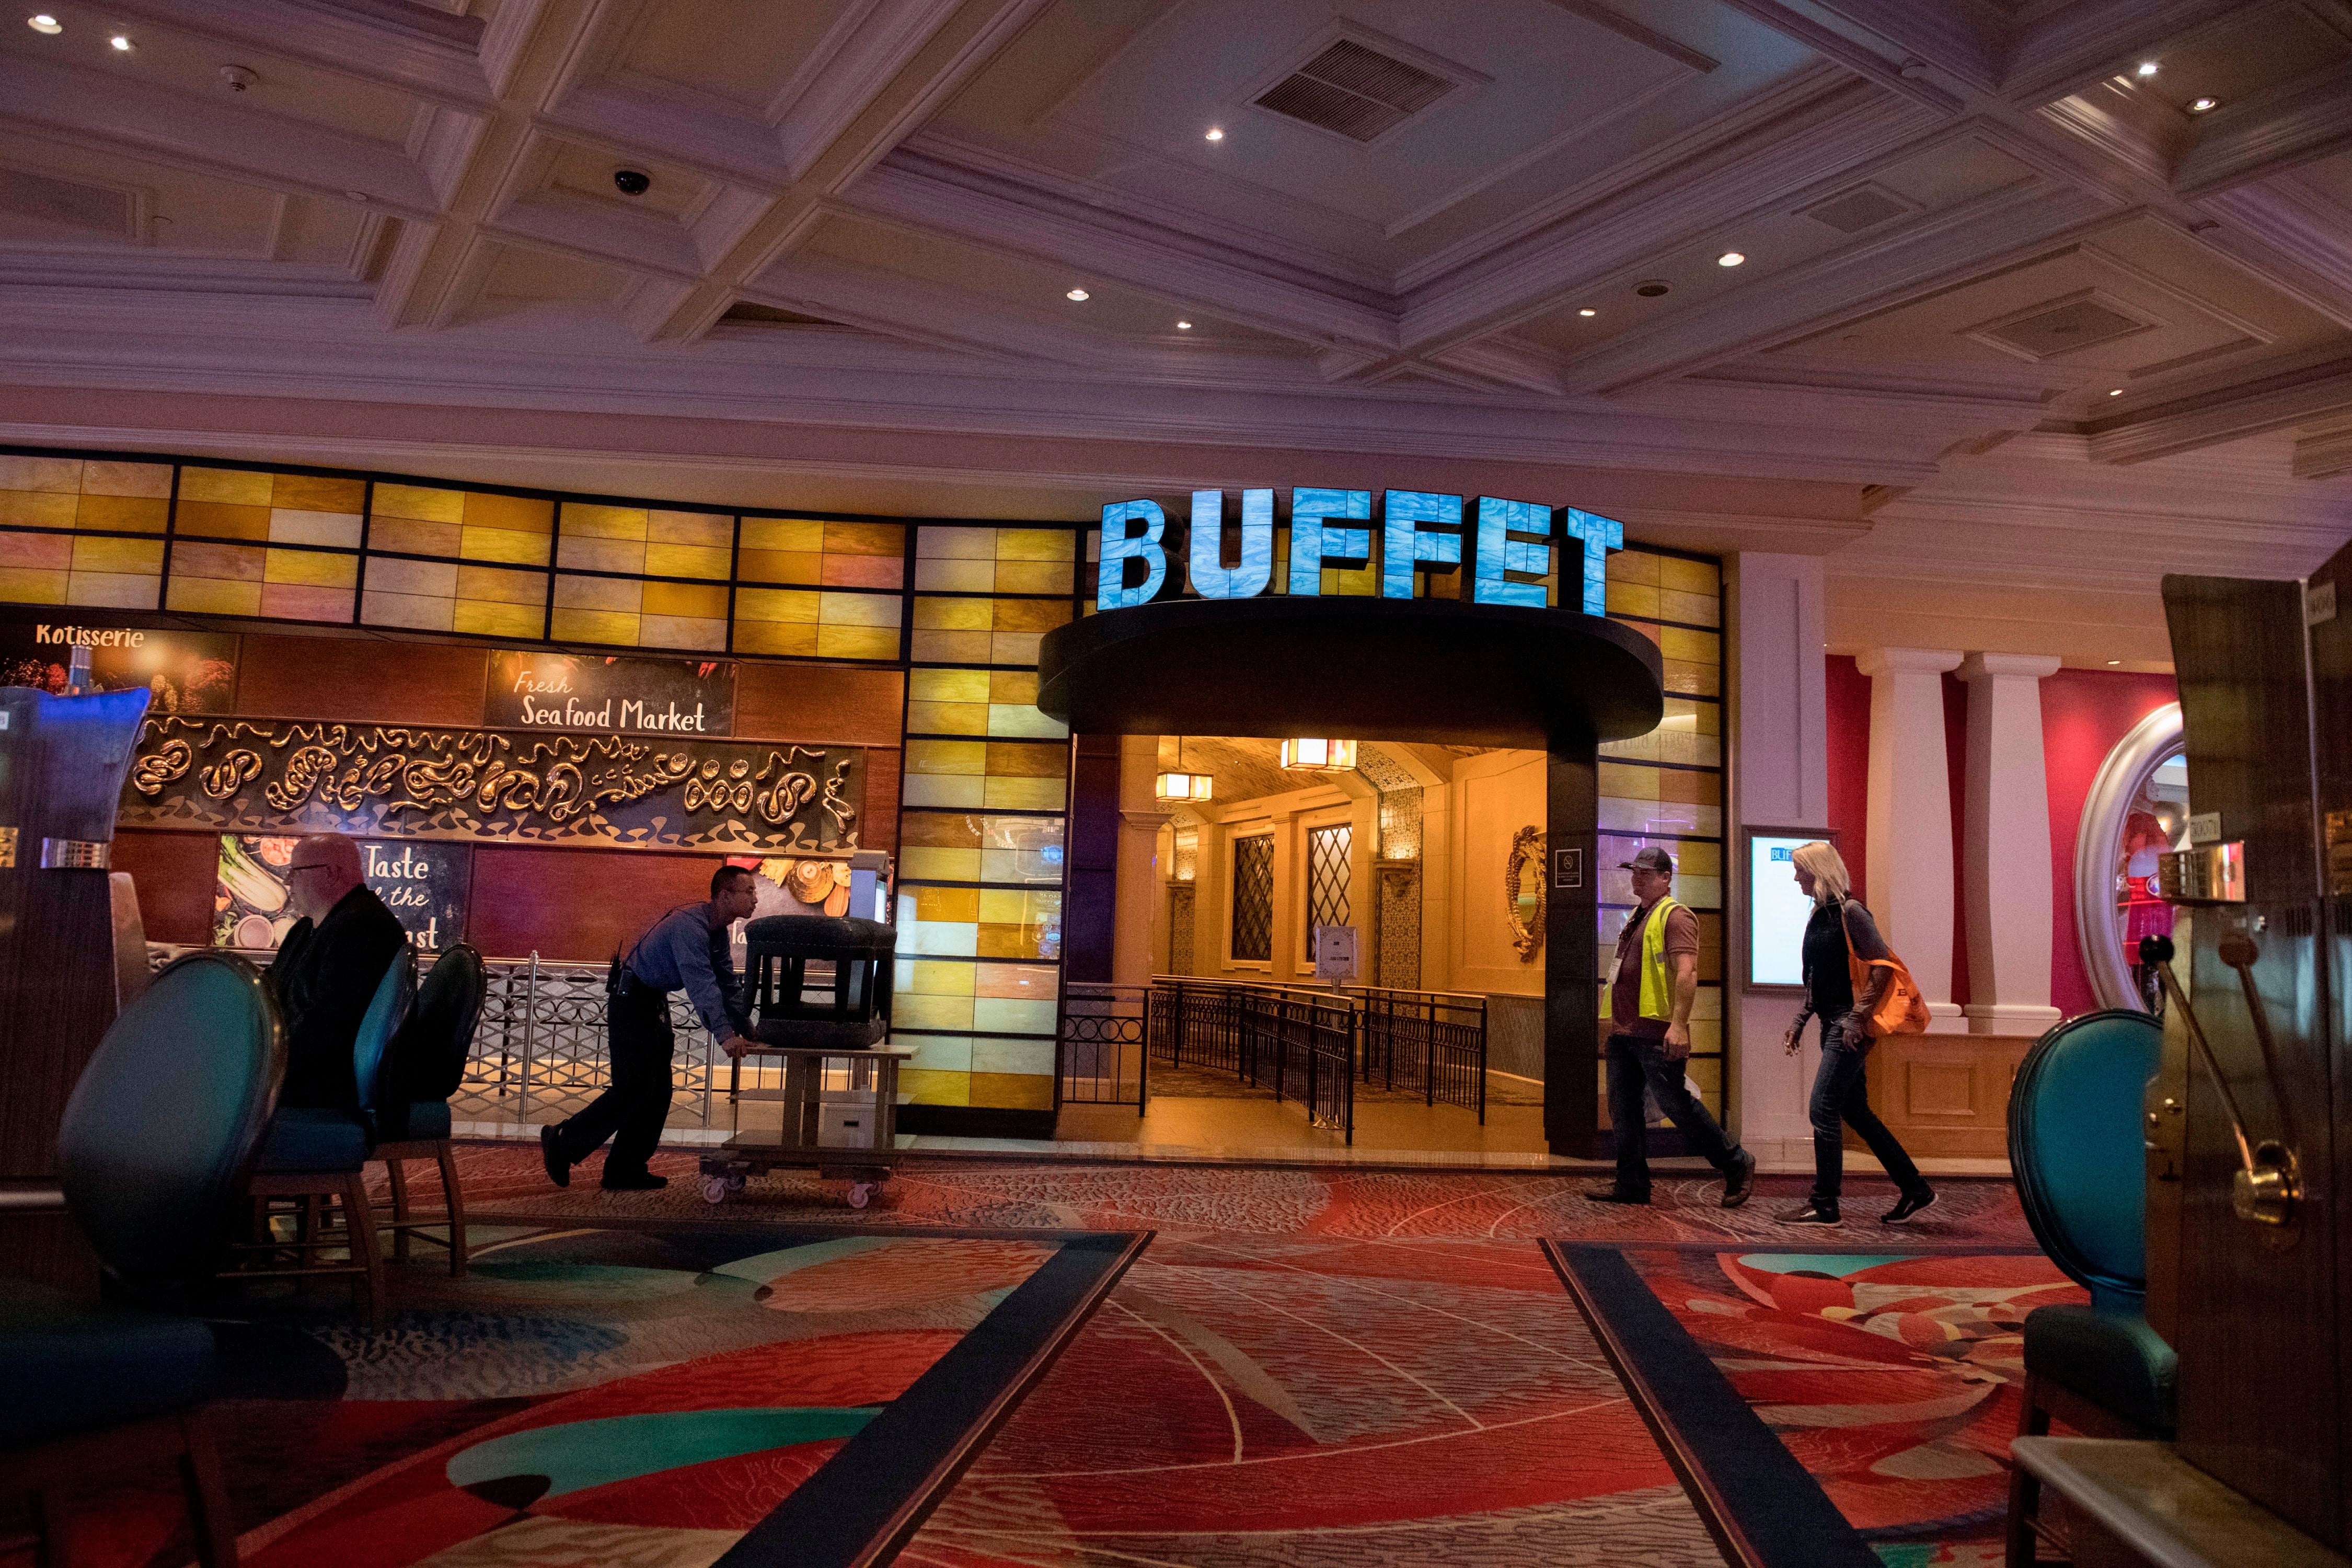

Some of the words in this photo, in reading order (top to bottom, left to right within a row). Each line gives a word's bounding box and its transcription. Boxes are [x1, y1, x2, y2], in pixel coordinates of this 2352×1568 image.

[1097, 486, 1623, 618] BUFFET
[514, 671, 573, 694] Fresh
[521, 695, 611, 728] Seafood
[620, 699, 705, 731] Market
[364, 845, 429, 879] Taste
[1772, 849, 1792, 860] BUF
[390, 886, 430, 906] the
